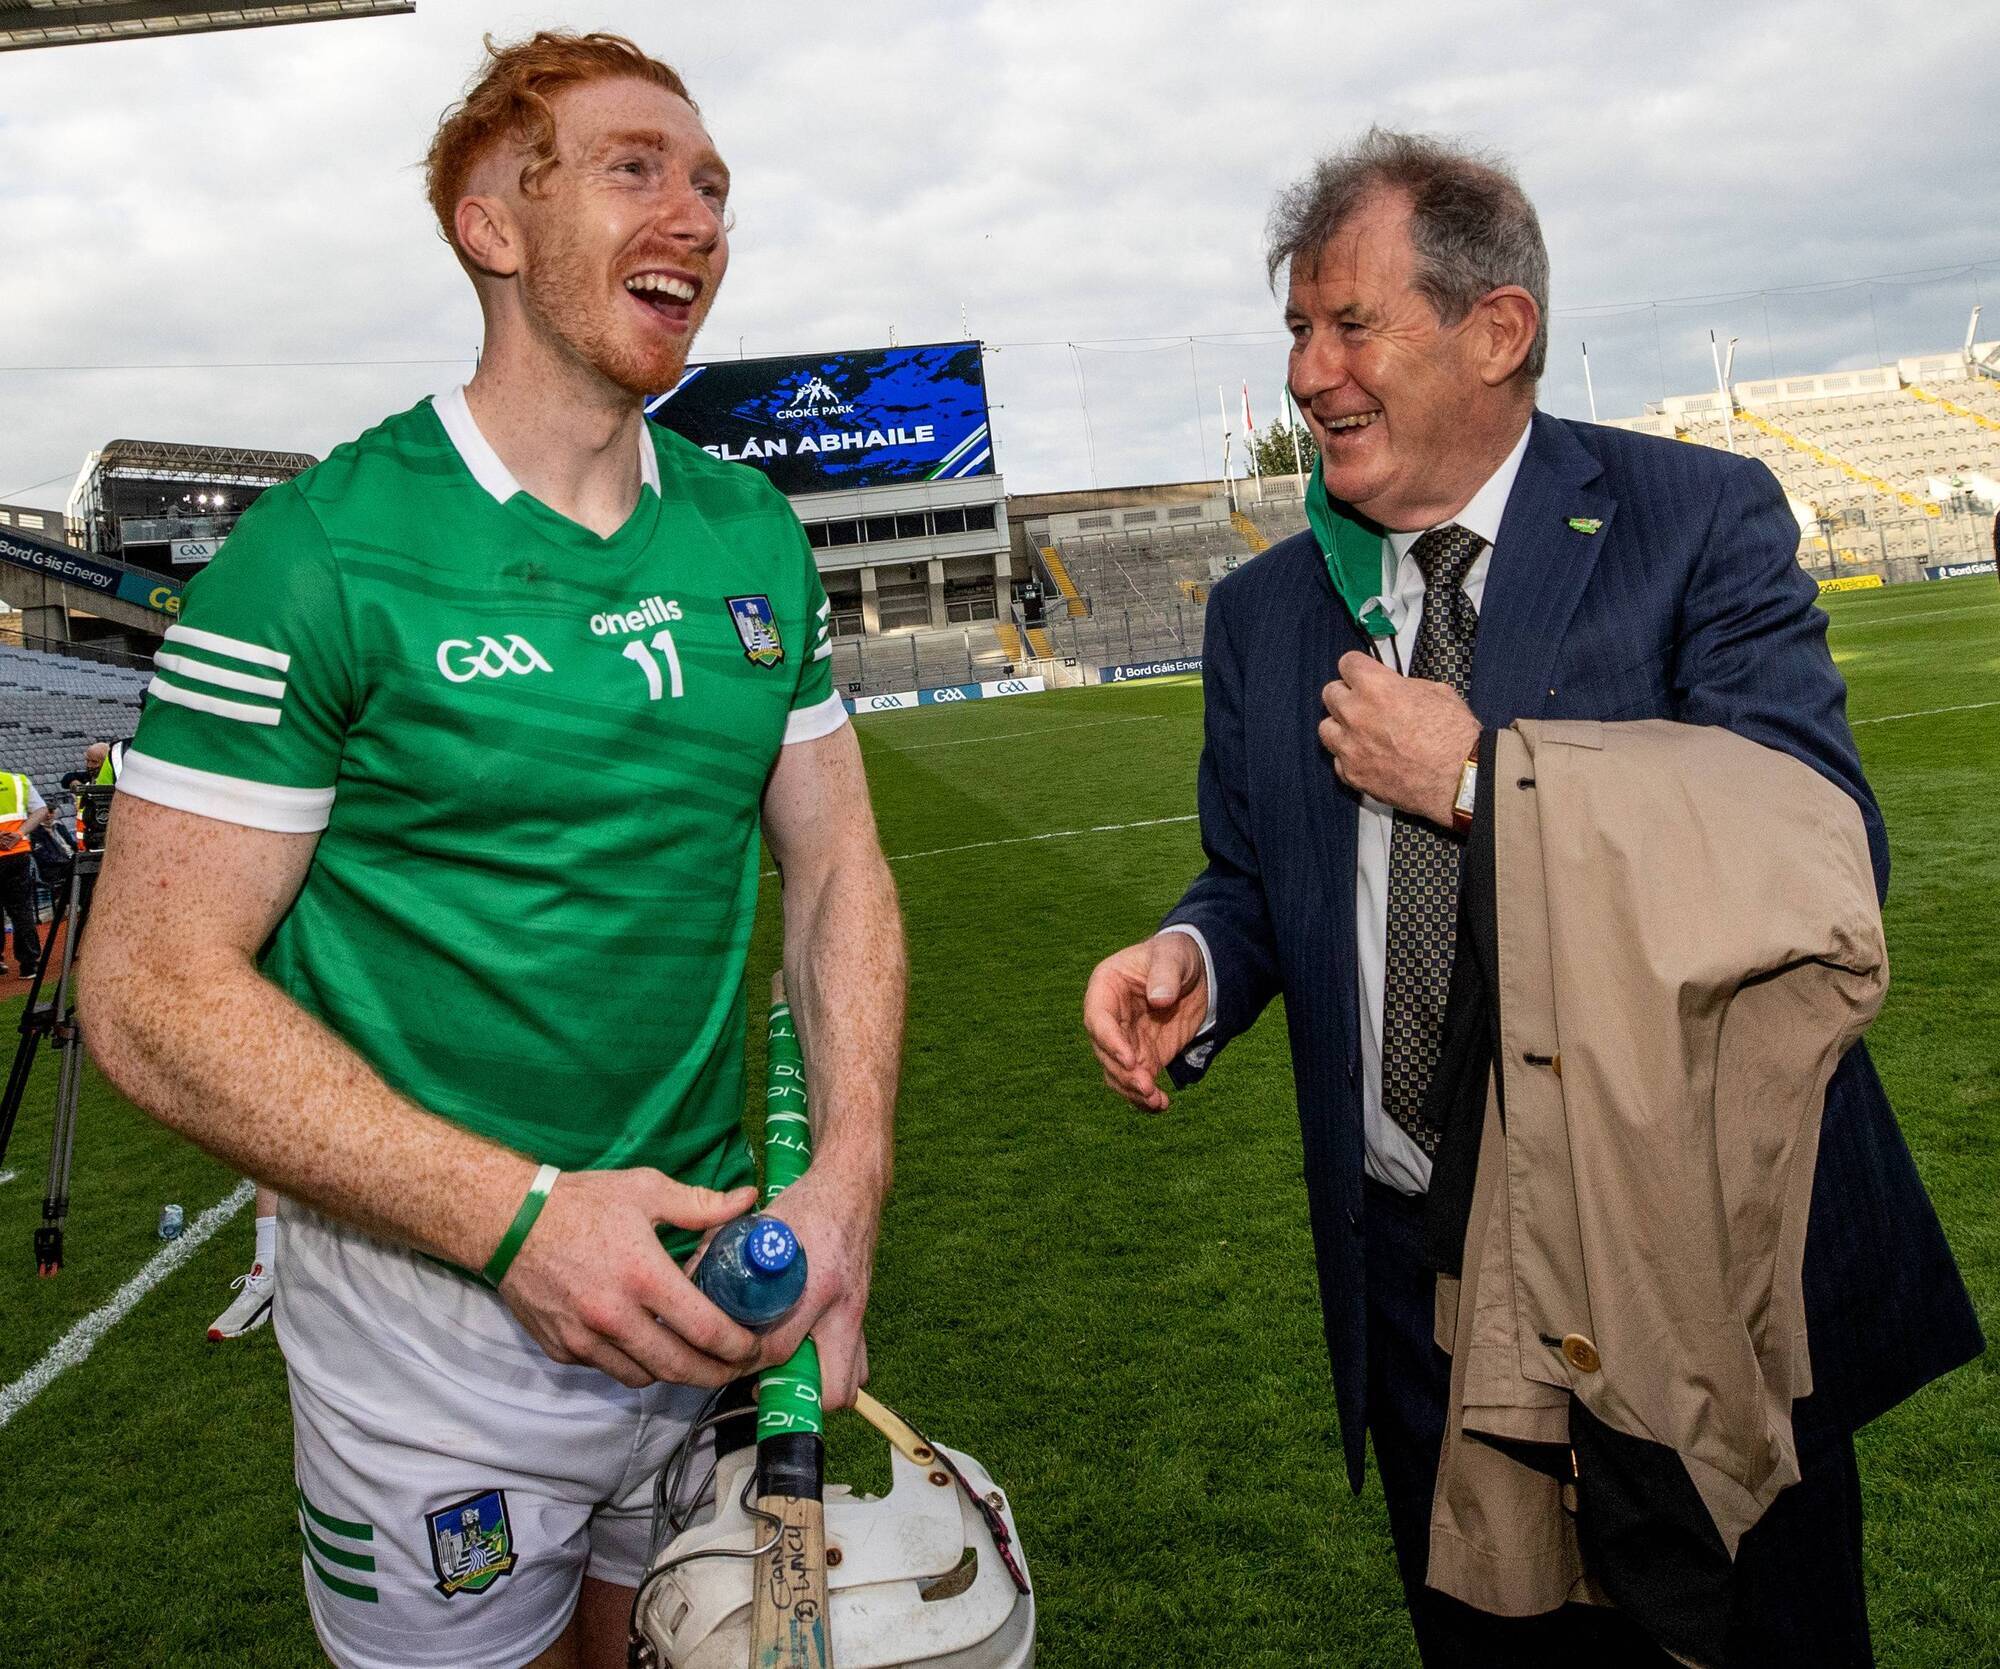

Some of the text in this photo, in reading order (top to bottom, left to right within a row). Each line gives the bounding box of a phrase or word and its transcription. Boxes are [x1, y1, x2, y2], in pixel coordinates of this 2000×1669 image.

[776, 404, 855, 419] CROKE PARK
[796, 425, 935, 455] ABHAILE
[180, 544, 208, 556] GAA
[0, 540, 33, 560] Bord
[62, 561, 113, 588] Energy
[1948, 565, 1972, 577] Bord
[436, 634, 554, 683] GAA
[622, 629, 684, 700] 11
[1126, 665, 1151, 677] Bord
[1152, 662, 1175, 674] Gáis
[933, 687, 966, 702] GAA
[997, 680, 1029, 694] GAA
[871, 696, 903, 709] GAA
